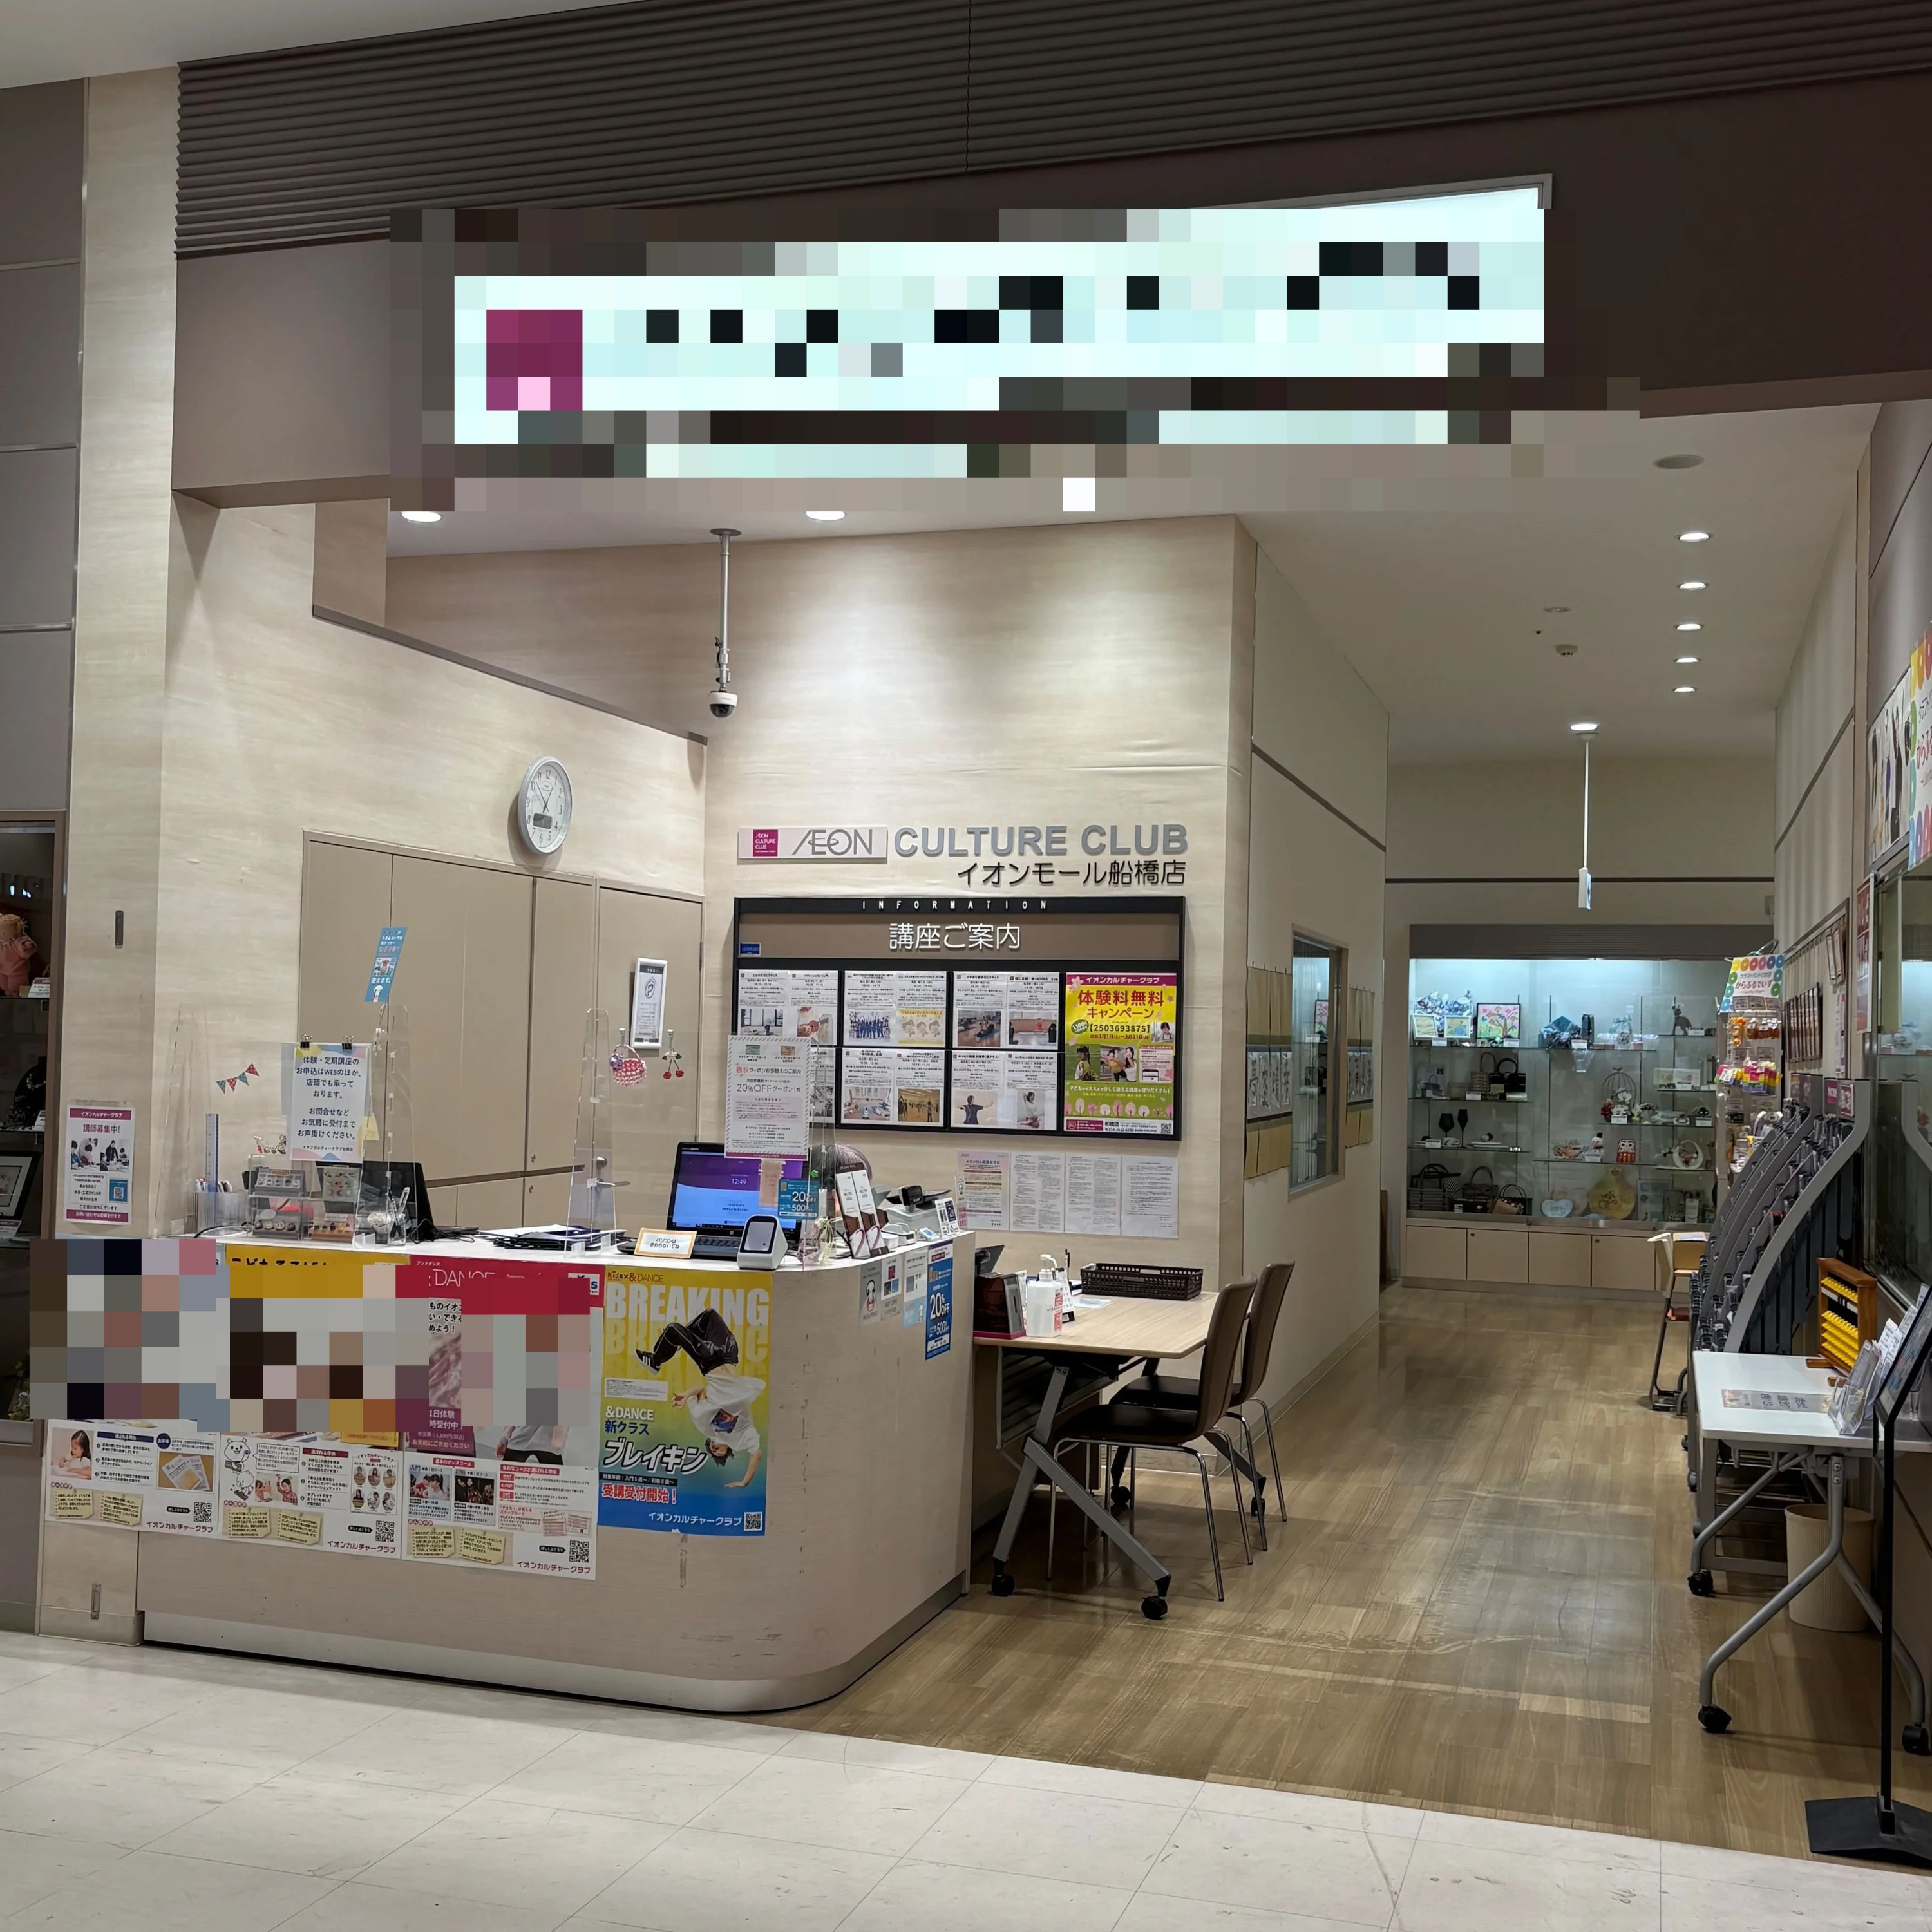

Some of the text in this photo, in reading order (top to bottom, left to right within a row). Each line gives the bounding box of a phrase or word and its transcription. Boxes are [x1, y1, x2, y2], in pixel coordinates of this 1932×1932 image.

[546, 769, 551, 779] 12
[894, 824, 1188, 857] CULTURE CLUB
[958, 858, 1186, 886] イオンモール船橋店
[862, 900, 1046, 910] INFORMATION
[889, 922, 1020, 950] 講座ご案内
[1086, 976, 1160, 985] イオンカルチャークラブ
[1077, 989, 1164, 1007] 体験料無料
[1086, 1007, 1155, 1019] キャンペーン
[303, 1056, 359, 1066] 体験・定期講座の
[306, 1079, 354, 1088] 店頭でも承って
[313, 1090, 343, 1099] おります。
[308, 1107, 350, 1116] お問合せなど
[301, 1118, 356, 1128] お気軽に受付まで
[297, 1130, 355, 1139] お声掛けください。
[607, 1282, 769, 1327] BREAKING
[604, 1420, 650, 1435] 新クラス
[603, 1437, 709, 1475] ブレイキン
[602, 1483, 677, 1505] 受講受付開始！
[648, 1512, 742, 1526] イオンカルチャークラブ
[146, 1521, 213, 1533] イオンカルチャークラブ
[327, 1540, 396, 1554] イオンカルチャークラブ
[516, 1560, 591, 1574] イオンカルチャークラブ
